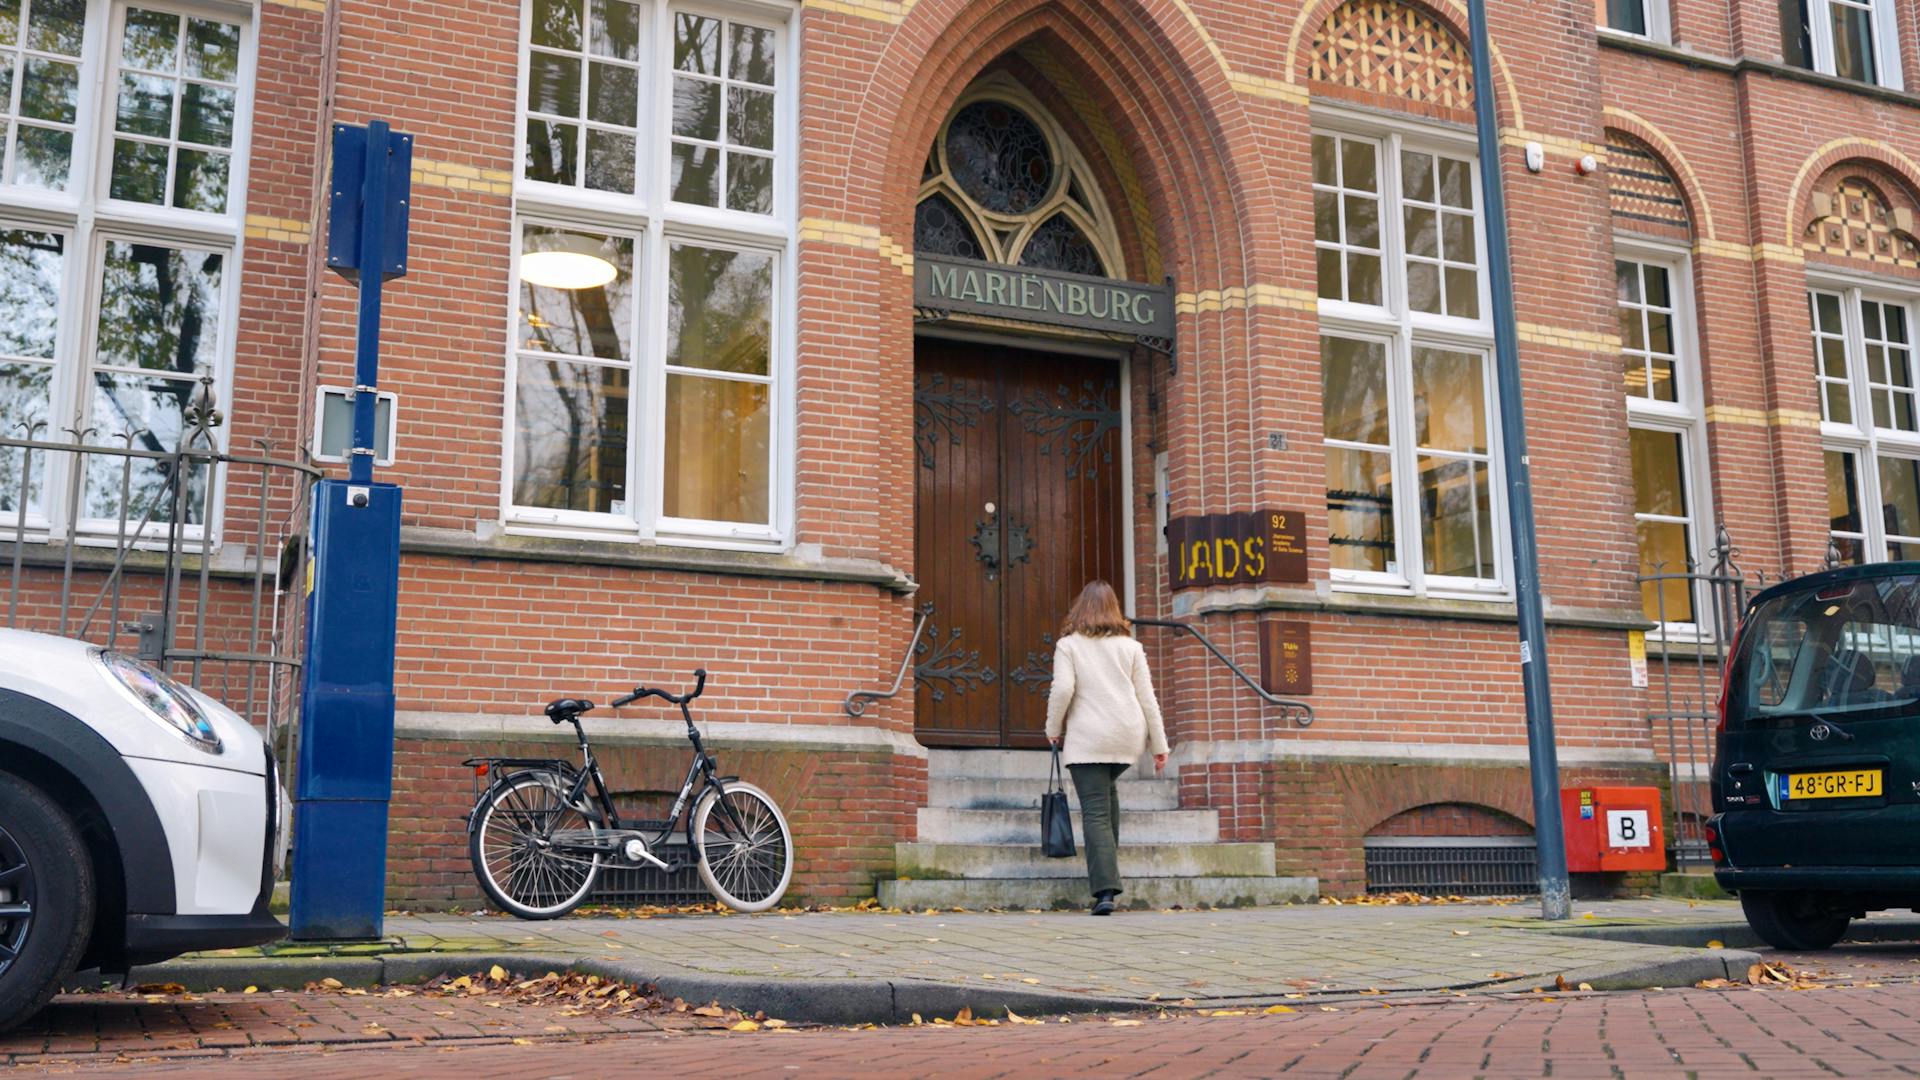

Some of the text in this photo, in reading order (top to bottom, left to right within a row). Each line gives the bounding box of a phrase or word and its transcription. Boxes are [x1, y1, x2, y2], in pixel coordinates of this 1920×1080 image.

[930, 263, 1155, 325] MARIËNBURG
[1271, 514, 1286, 529] 92
[1179, 536, 1265, 581] JADS
[1620, 816, 1636, 841] B
